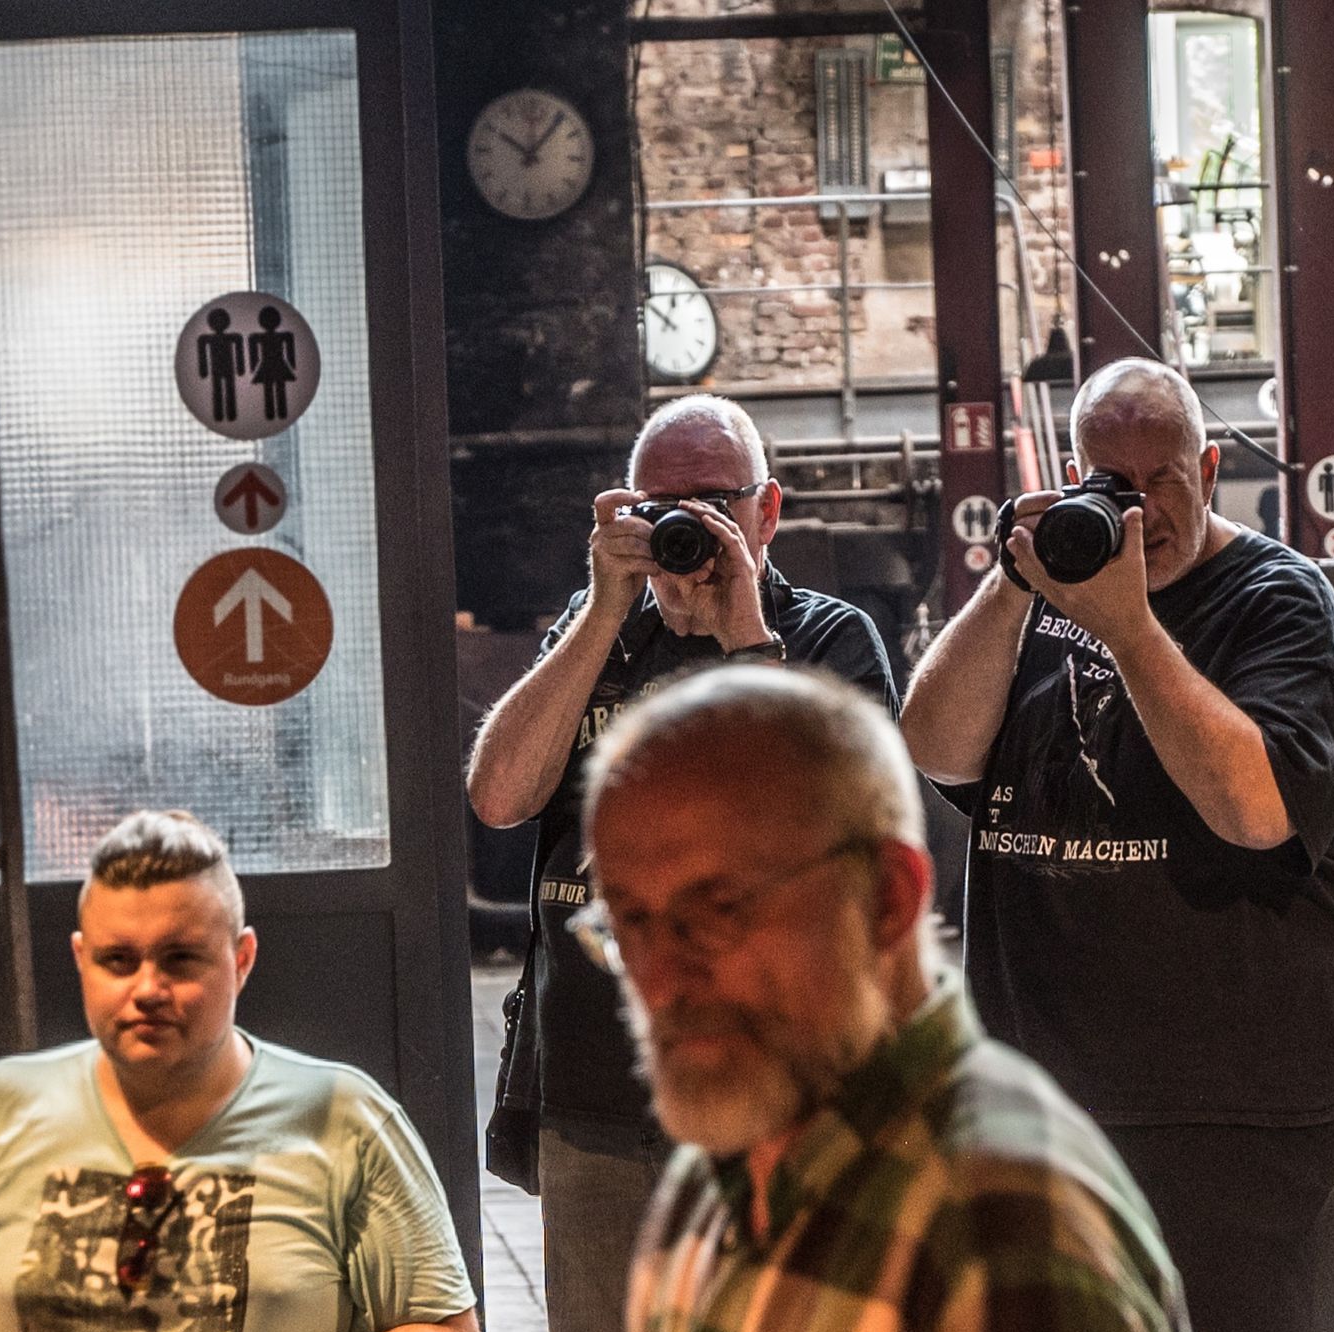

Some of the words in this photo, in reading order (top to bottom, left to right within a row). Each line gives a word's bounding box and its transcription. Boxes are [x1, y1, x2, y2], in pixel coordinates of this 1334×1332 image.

[991, 785, 1013, 802] AS
[1063, 838, 1168, 863] MACHEN!
[557, 882, 587, 905] NUR
